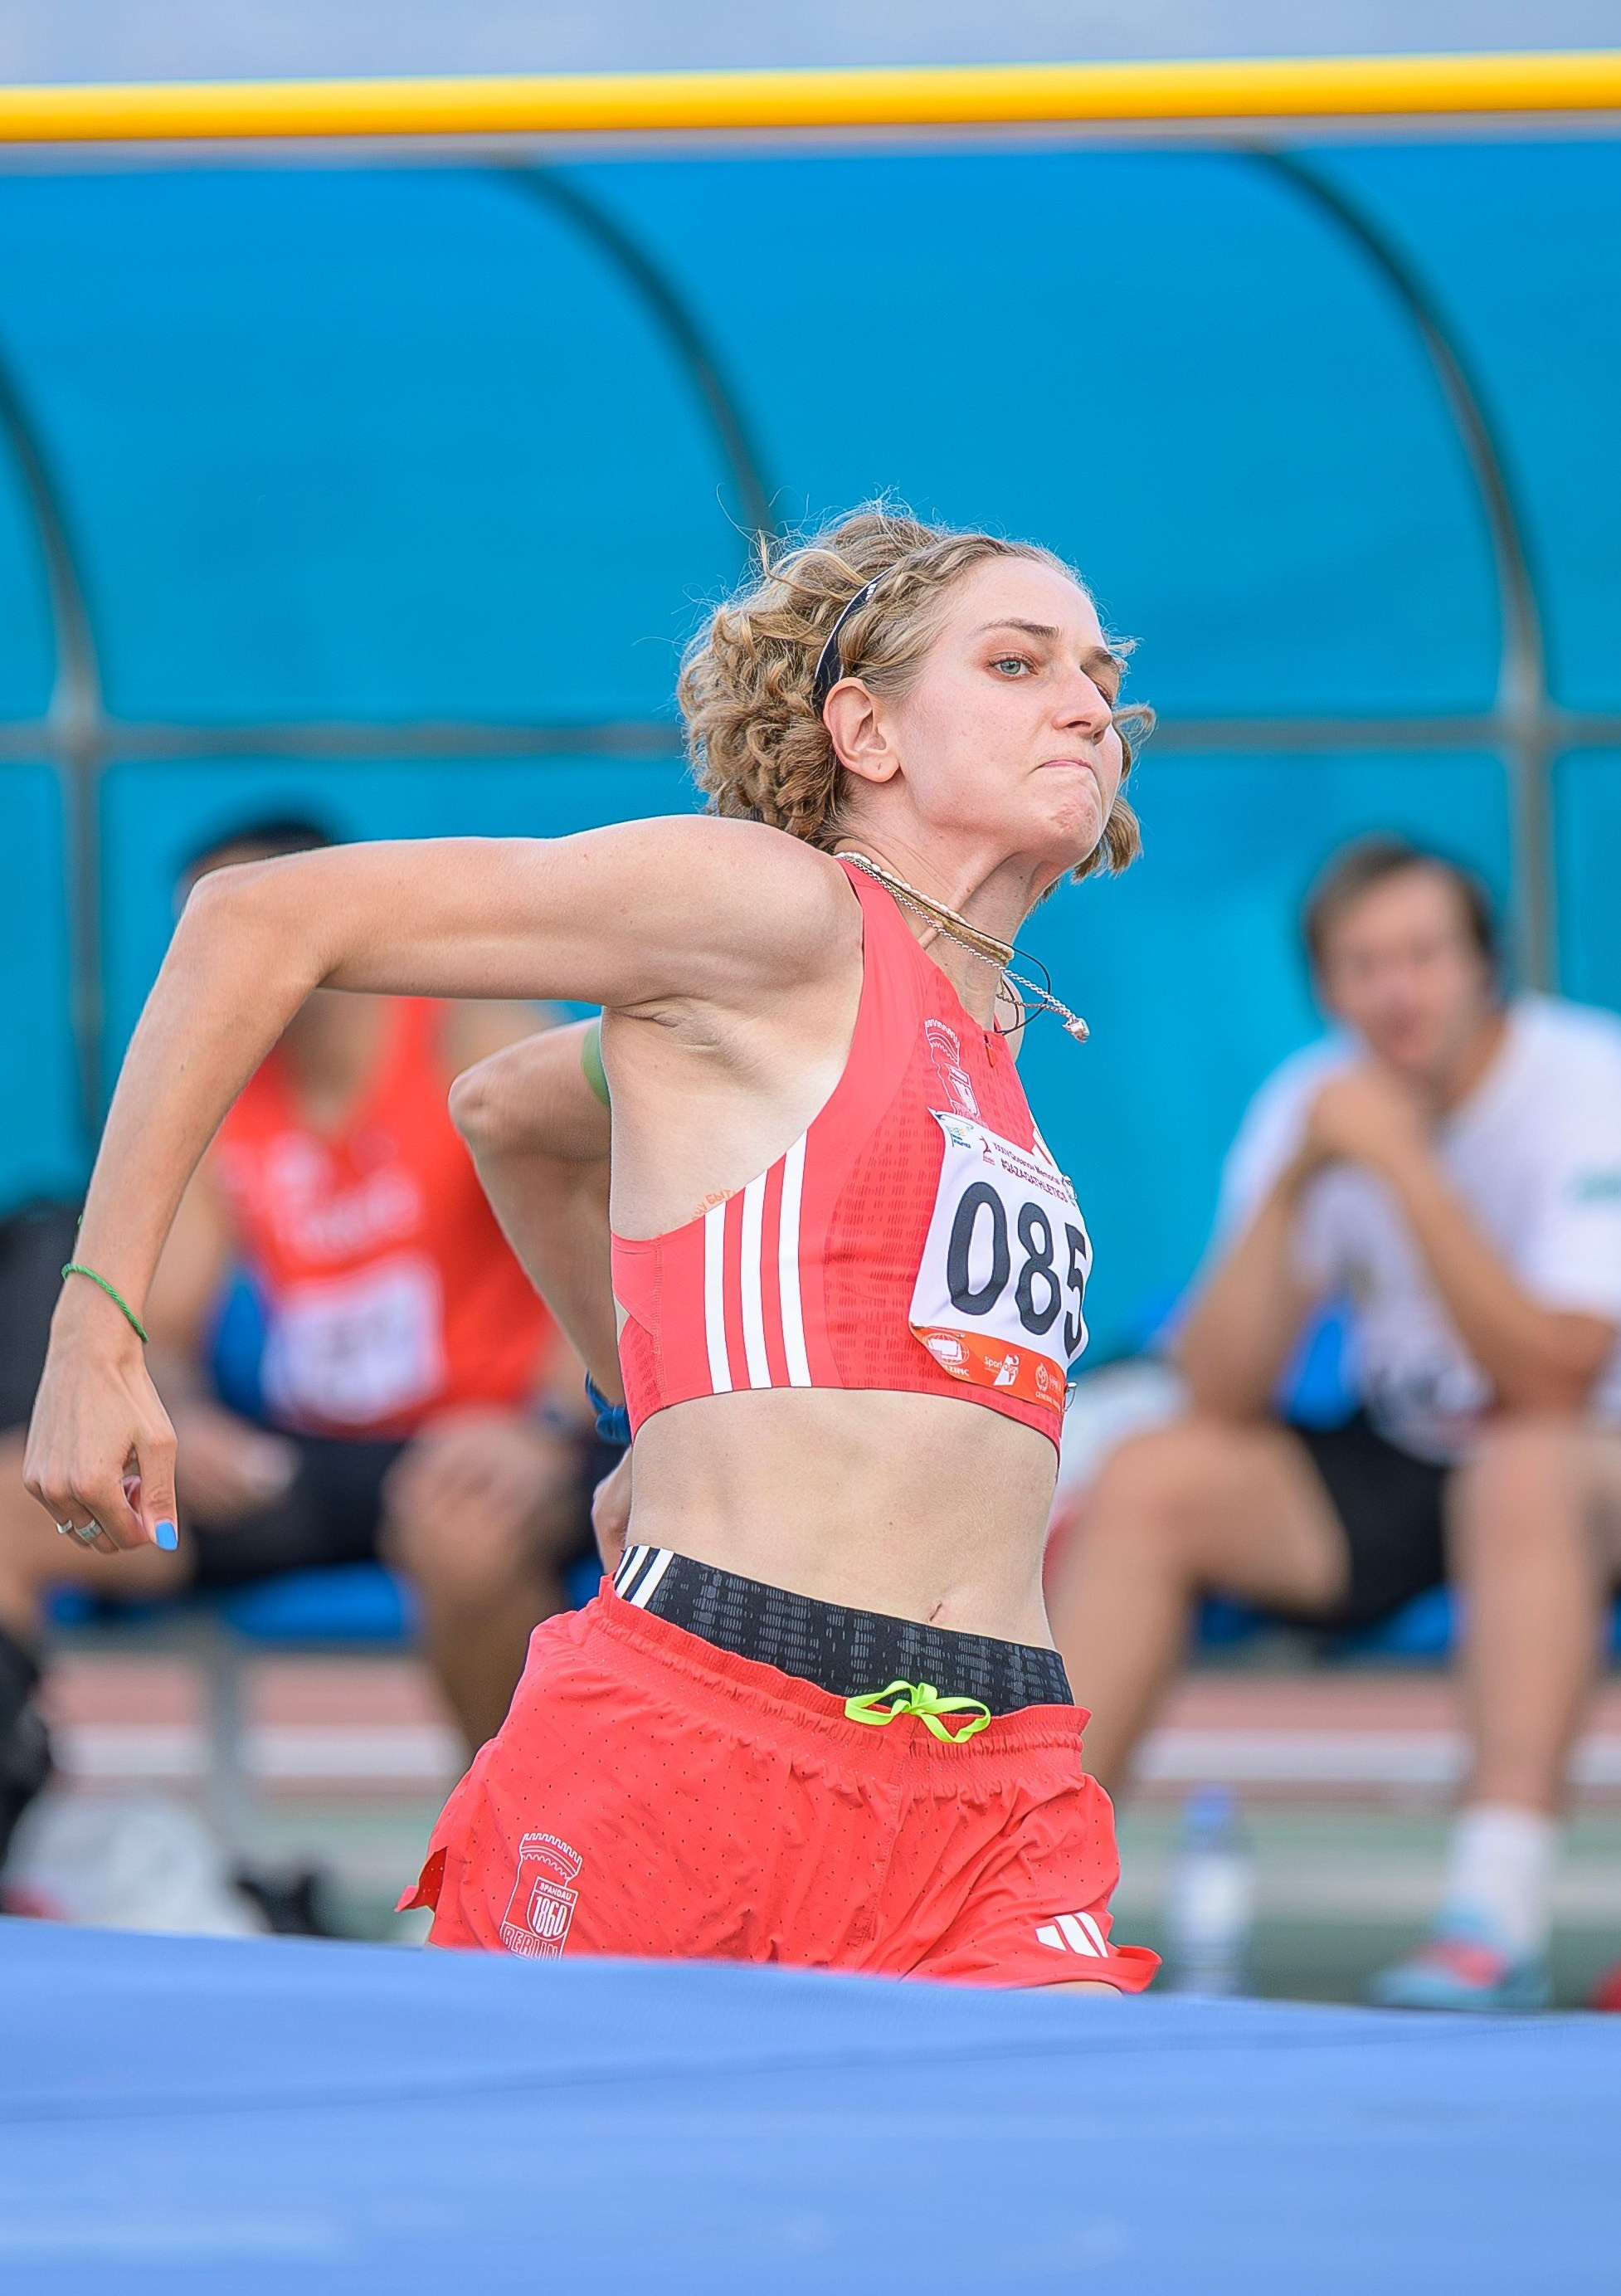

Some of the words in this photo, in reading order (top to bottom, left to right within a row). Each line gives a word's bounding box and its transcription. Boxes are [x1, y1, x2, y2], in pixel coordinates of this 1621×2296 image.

[947, 1182, 1087, 1359] 085
[538, 1882, 572, 1901] SPANDAU
[532, 1895, 568, 1938] 1860
[503, 1925, 559, 1962] BERLIN
